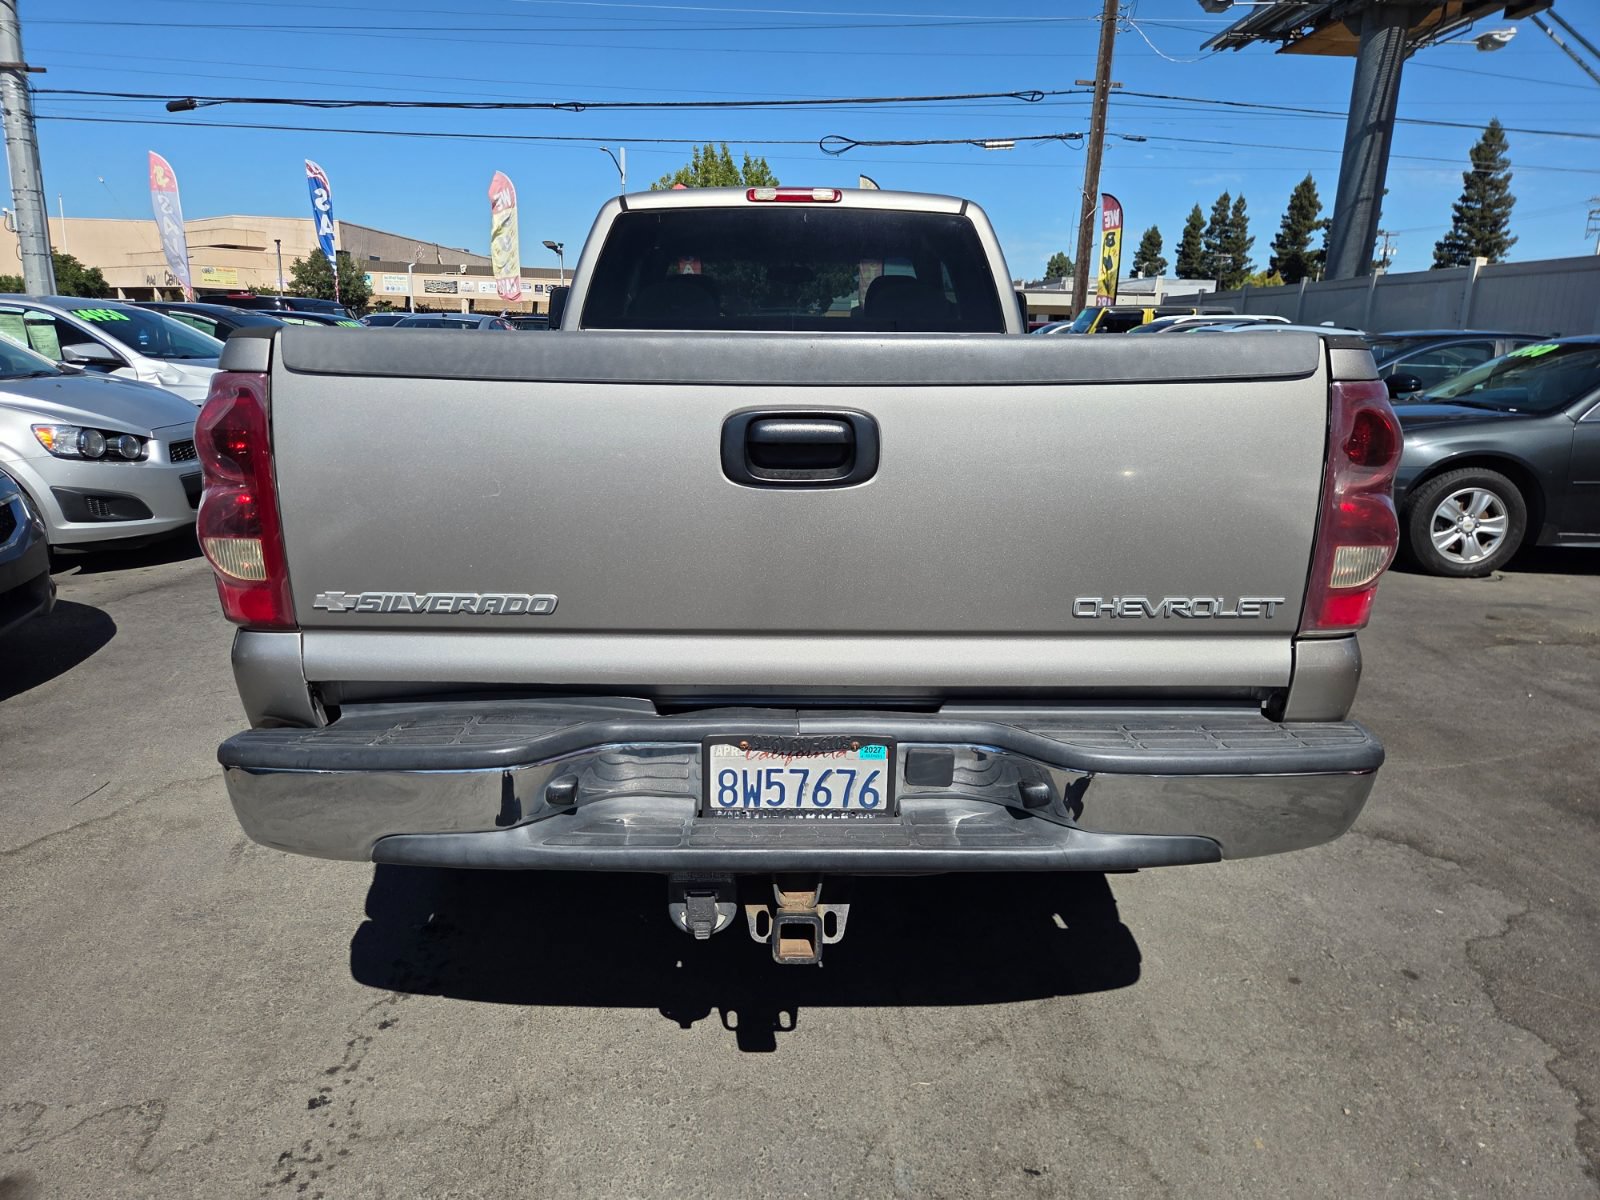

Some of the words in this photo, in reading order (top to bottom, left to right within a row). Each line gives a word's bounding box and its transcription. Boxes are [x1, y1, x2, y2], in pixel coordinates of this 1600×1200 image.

[355, 591, 559, 615] SILVERADO
[1071, 596, 1287, 619] CHEVROLET
[863, 746, 882, 754] 2027
[717, 768, 881, 810] 8W57676
